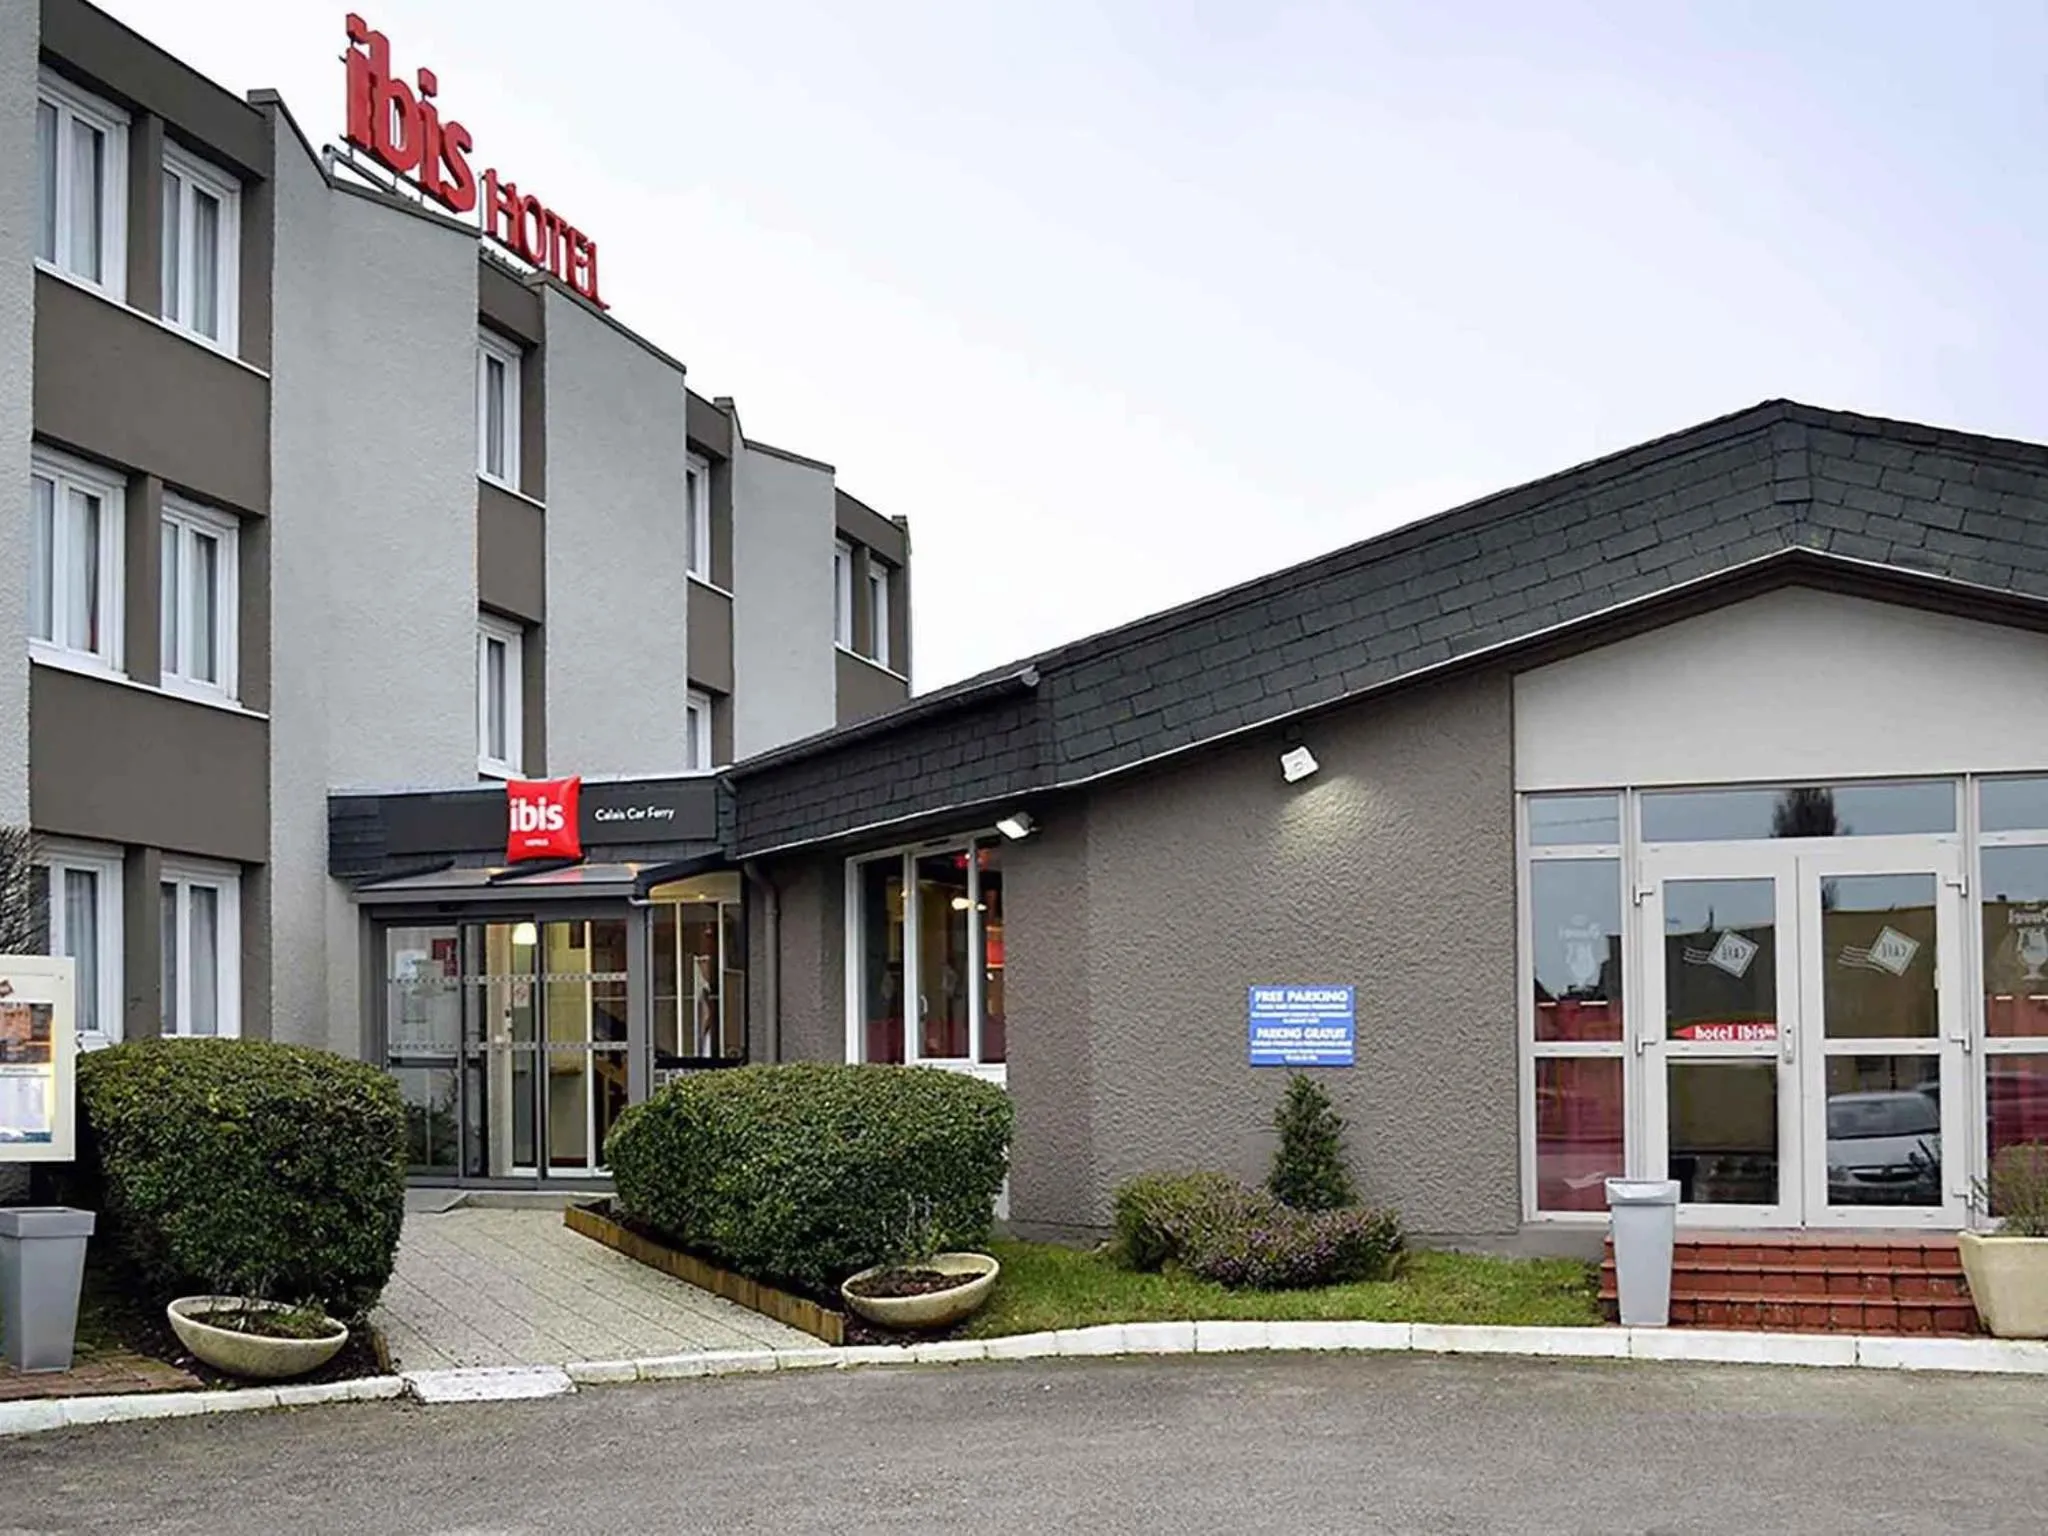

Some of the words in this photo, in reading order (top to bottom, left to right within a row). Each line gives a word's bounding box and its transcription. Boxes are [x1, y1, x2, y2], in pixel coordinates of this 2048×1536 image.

[346, 13, 476, 213] ibis
[484, 168, 609, 310] HOTEL
[510, 797, 564, 832] ibis
[1255, 990, 1284, 1002] FREE
[1287, 990, 1349, 1002] PARKING
[1694, 1025, 1733, 1040] hotel
